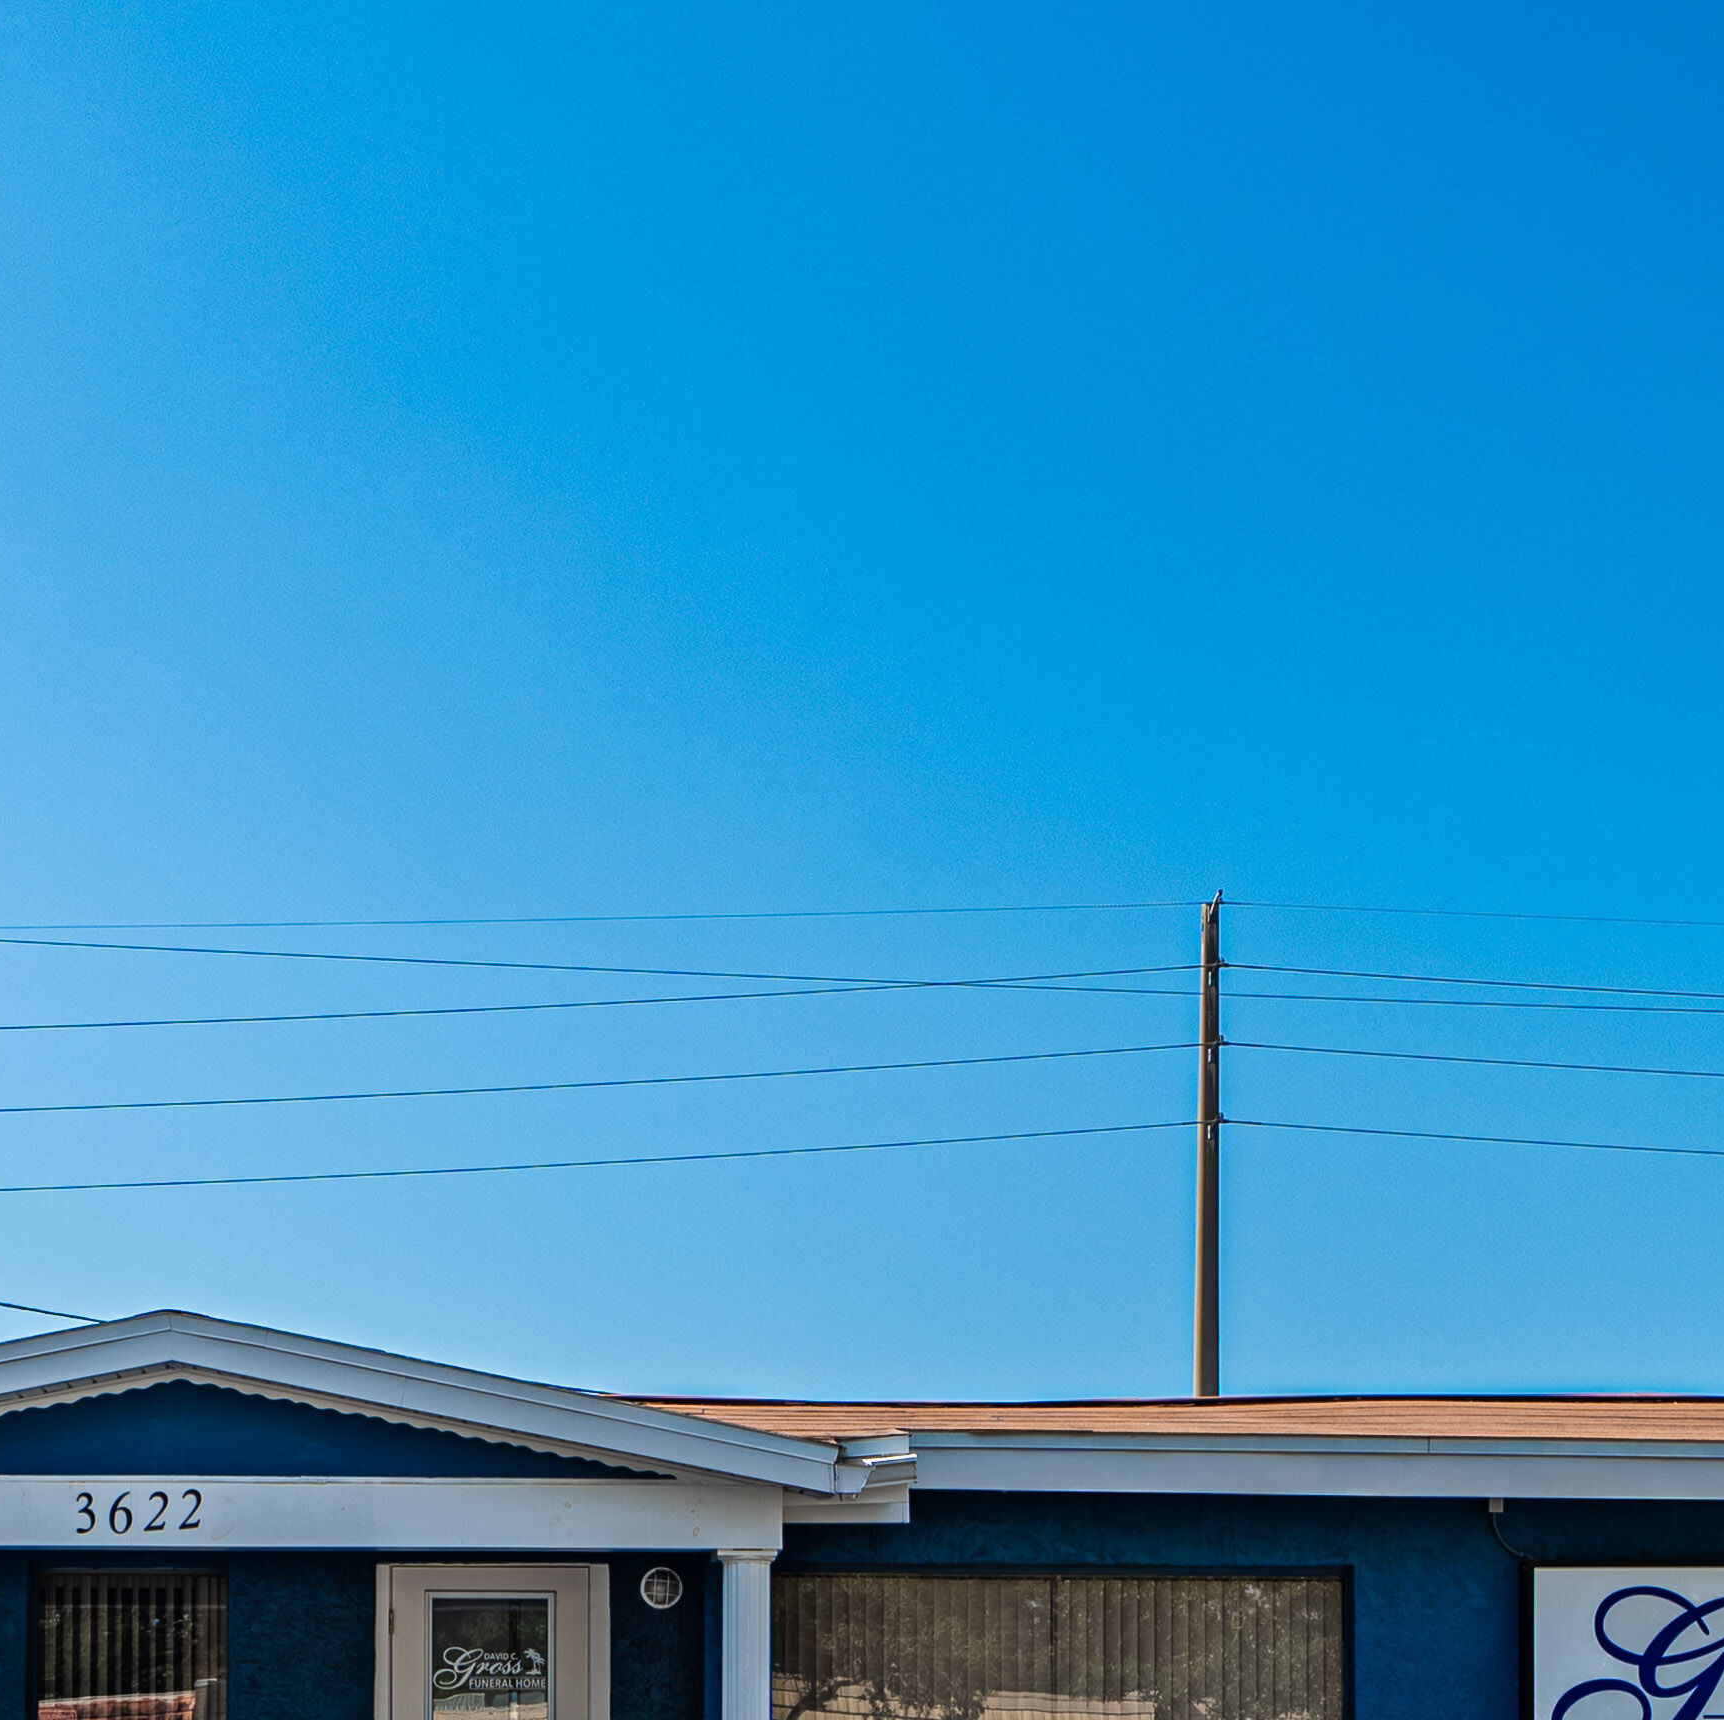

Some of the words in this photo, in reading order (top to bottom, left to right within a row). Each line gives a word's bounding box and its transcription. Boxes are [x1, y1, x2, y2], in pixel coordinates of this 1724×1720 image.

[76, 1488, 202, 1534] 3622
[433, 1646, 523, 1690] Gross
[484, 1652, 509, 1660] DAVID
[469, 1679, 514, 1688] FUNERAL
[515, 1679, 546, 1689] HOME
